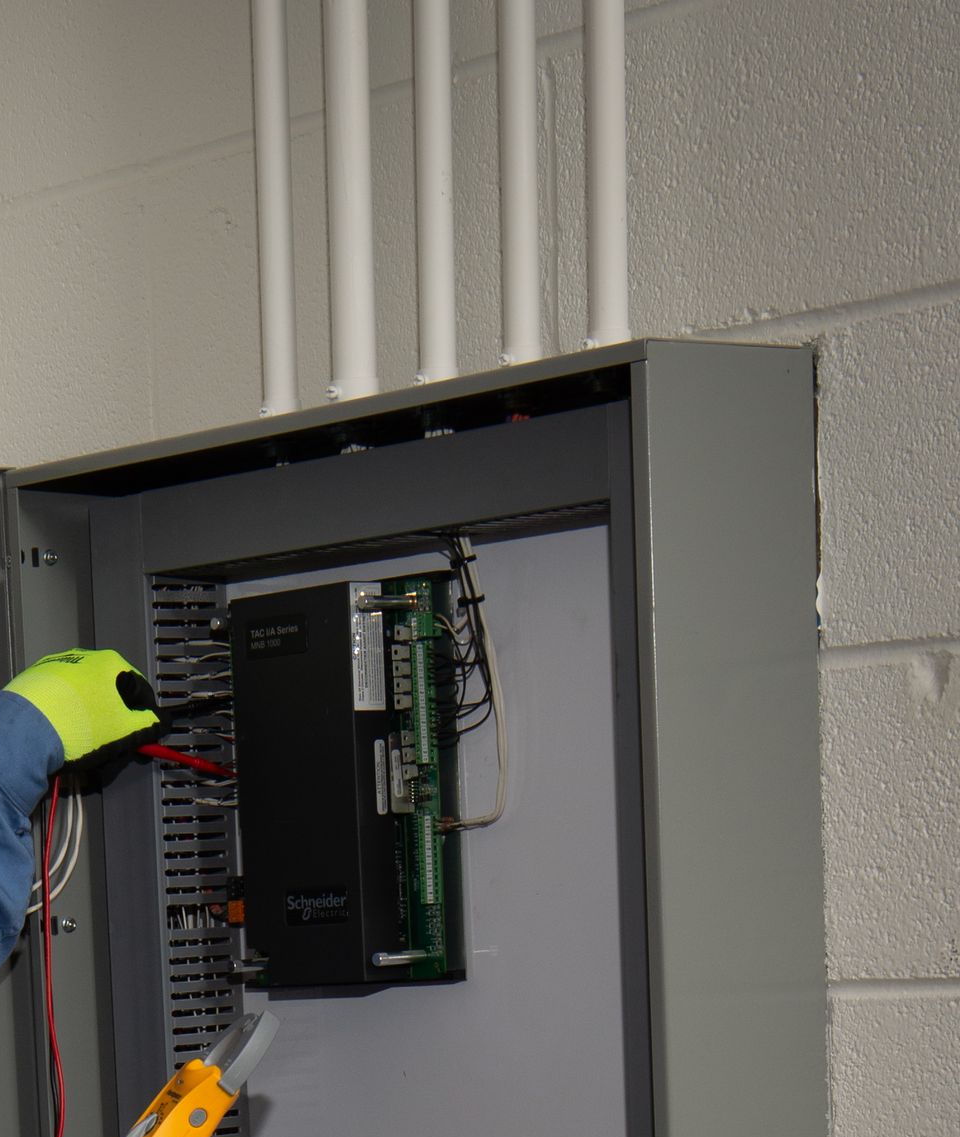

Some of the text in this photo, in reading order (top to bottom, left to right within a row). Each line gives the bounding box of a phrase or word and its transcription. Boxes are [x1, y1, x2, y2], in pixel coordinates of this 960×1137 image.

[250, 628, 264, 639] TAC
[276, 624, 299, 635] Series
[287, 892, 347, 910] Schneider
